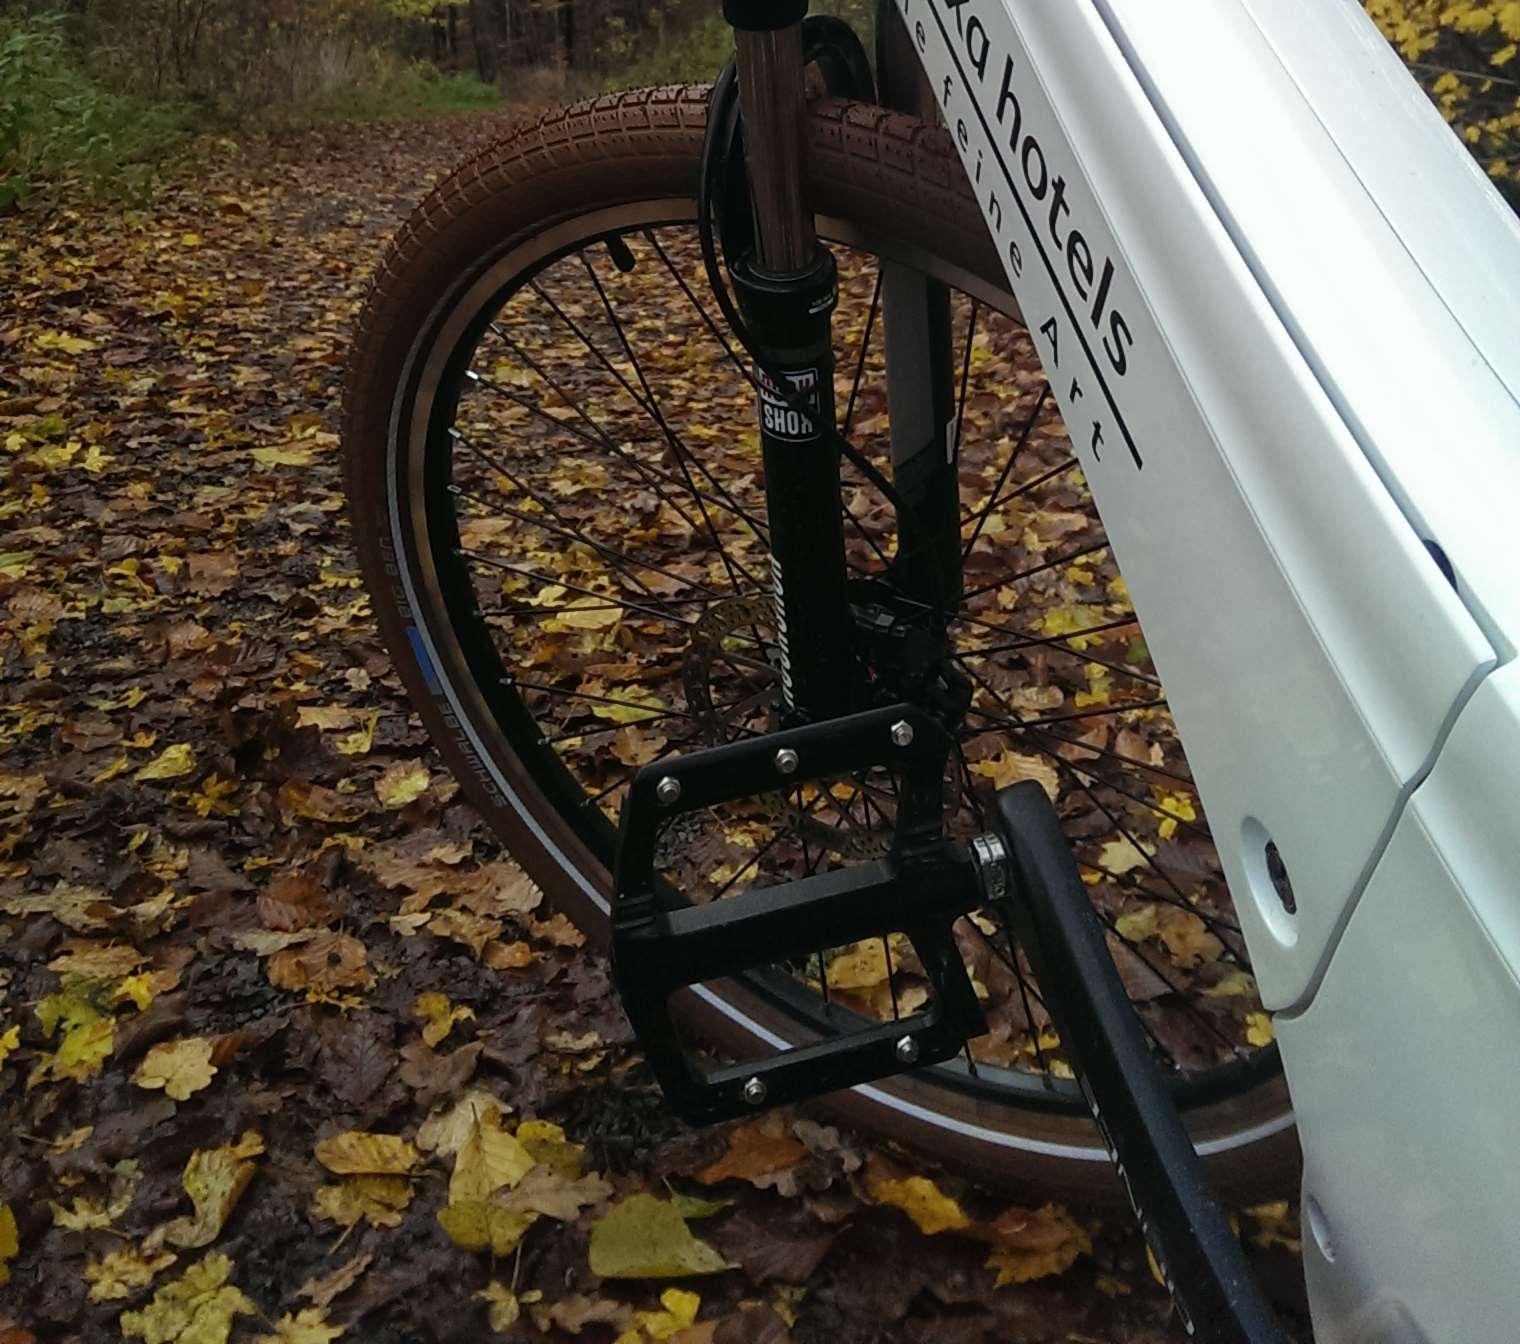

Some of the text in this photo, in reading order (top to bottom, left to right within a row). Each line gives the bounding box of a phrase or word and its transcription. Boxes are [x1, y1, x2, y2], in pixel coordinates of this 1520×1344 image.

[941, 75, 1024, 282] feine
[1040, 316, 1105, 464] Art
[996, 56, 1134, 378] hotels
